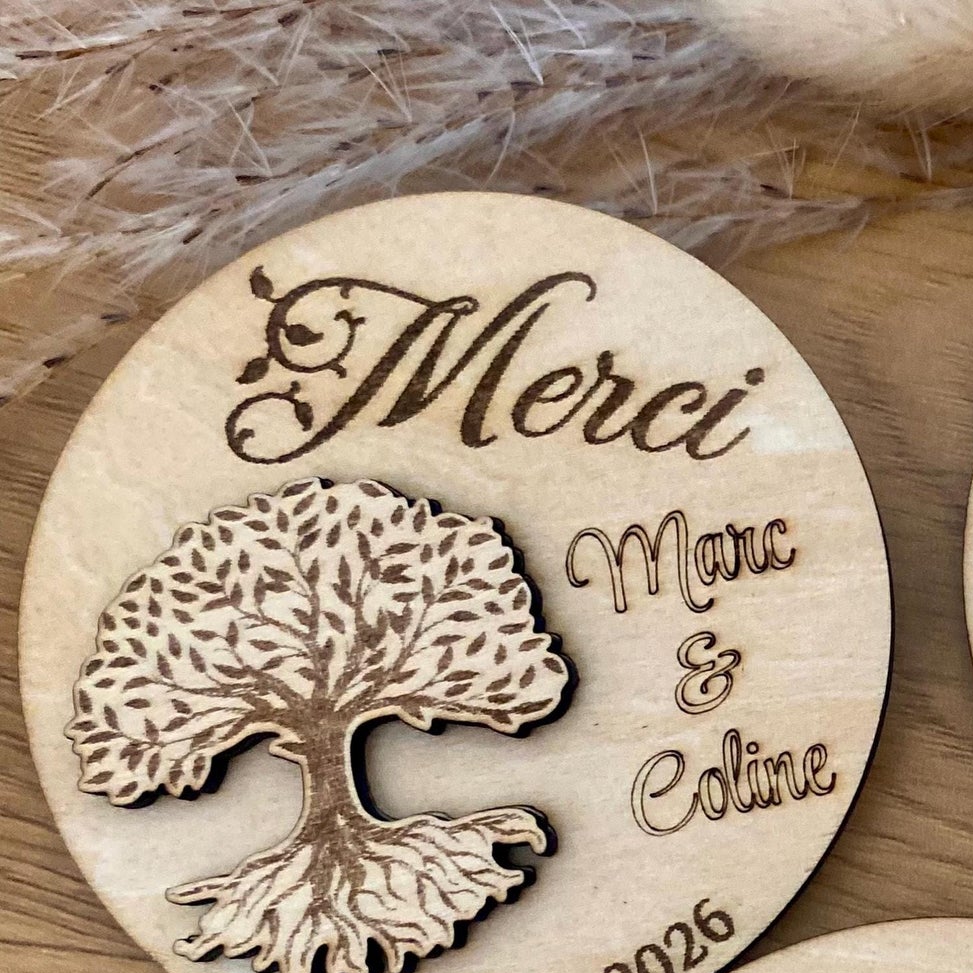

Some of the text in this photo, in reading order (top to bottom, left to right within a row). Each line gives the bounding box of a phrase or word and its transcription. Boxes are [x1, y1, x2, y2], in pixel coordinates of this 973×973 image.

[224, 265, 766, 464] Merci
[565, 509, 796, 614] Marc
[674, 631, 742, 714] &
[630, 729, 837, 836] Coline
